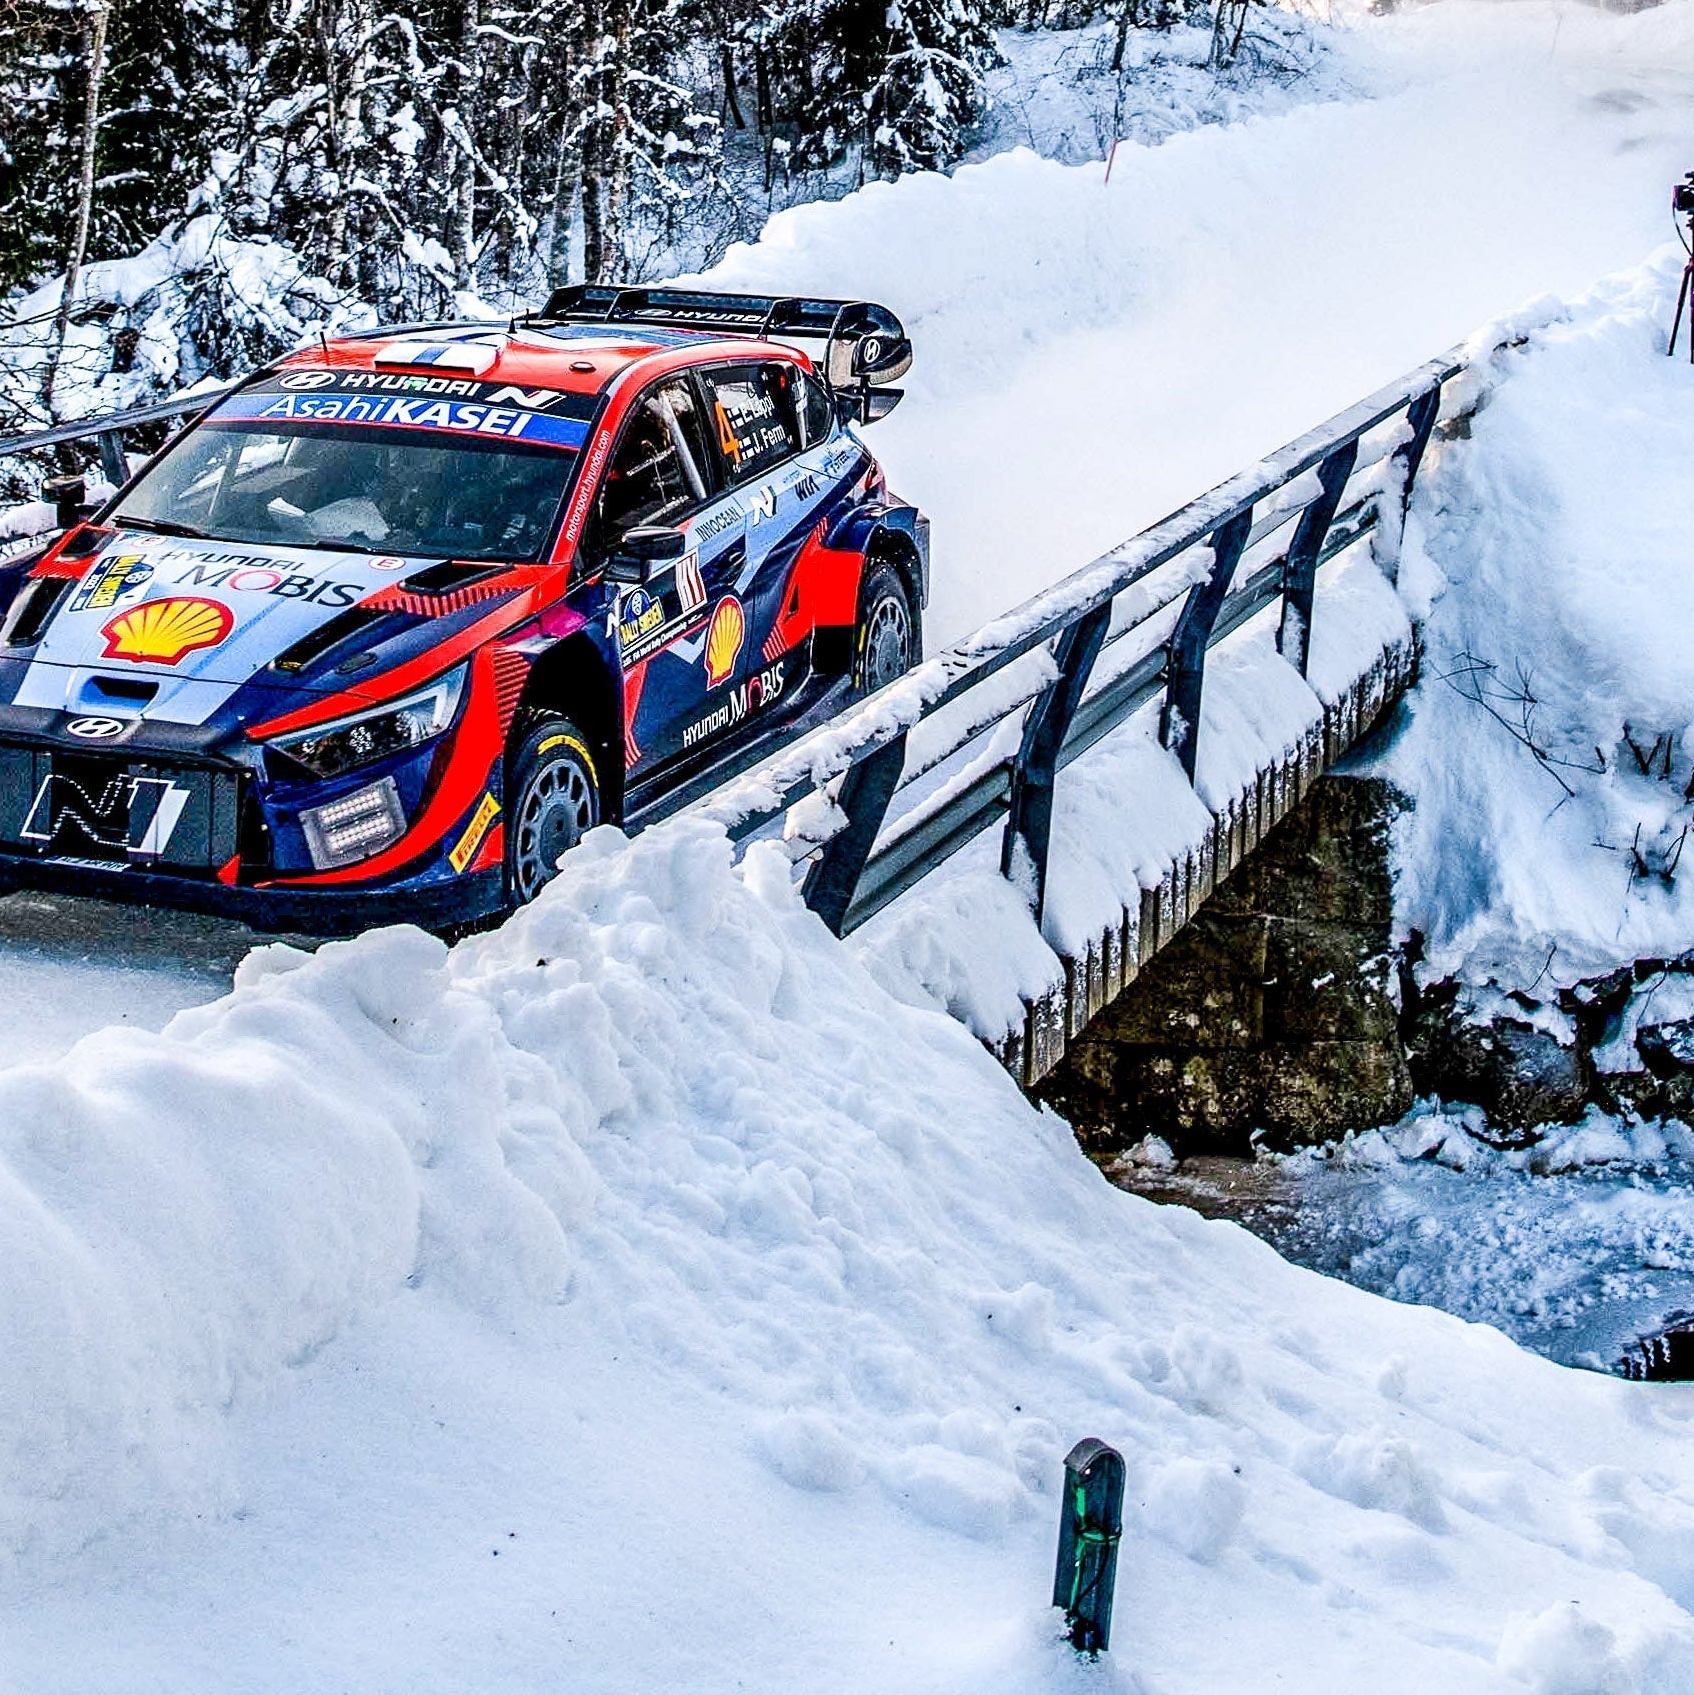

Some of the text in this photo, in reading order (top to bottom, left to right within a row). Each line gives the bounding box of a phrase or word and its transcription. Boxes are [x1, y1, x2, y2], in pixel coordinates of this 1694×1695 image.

[674, 311, 775, 324] HYUNDA
[340, 373, 482, 397] HYUNDAI
[714, 400, 741, 465] 4
[760, 424, 786, 449] Ferm
[566, 430, 611, 543] motorsport.hyundai.com
[694, 507, 742, 542] INNOCEAN
[161, 552, 305, 571] HYUNDAI
[172, 564, 367, 607] MOBIS
[682, 661, 785, 748] HYUNDAI MOBIS
